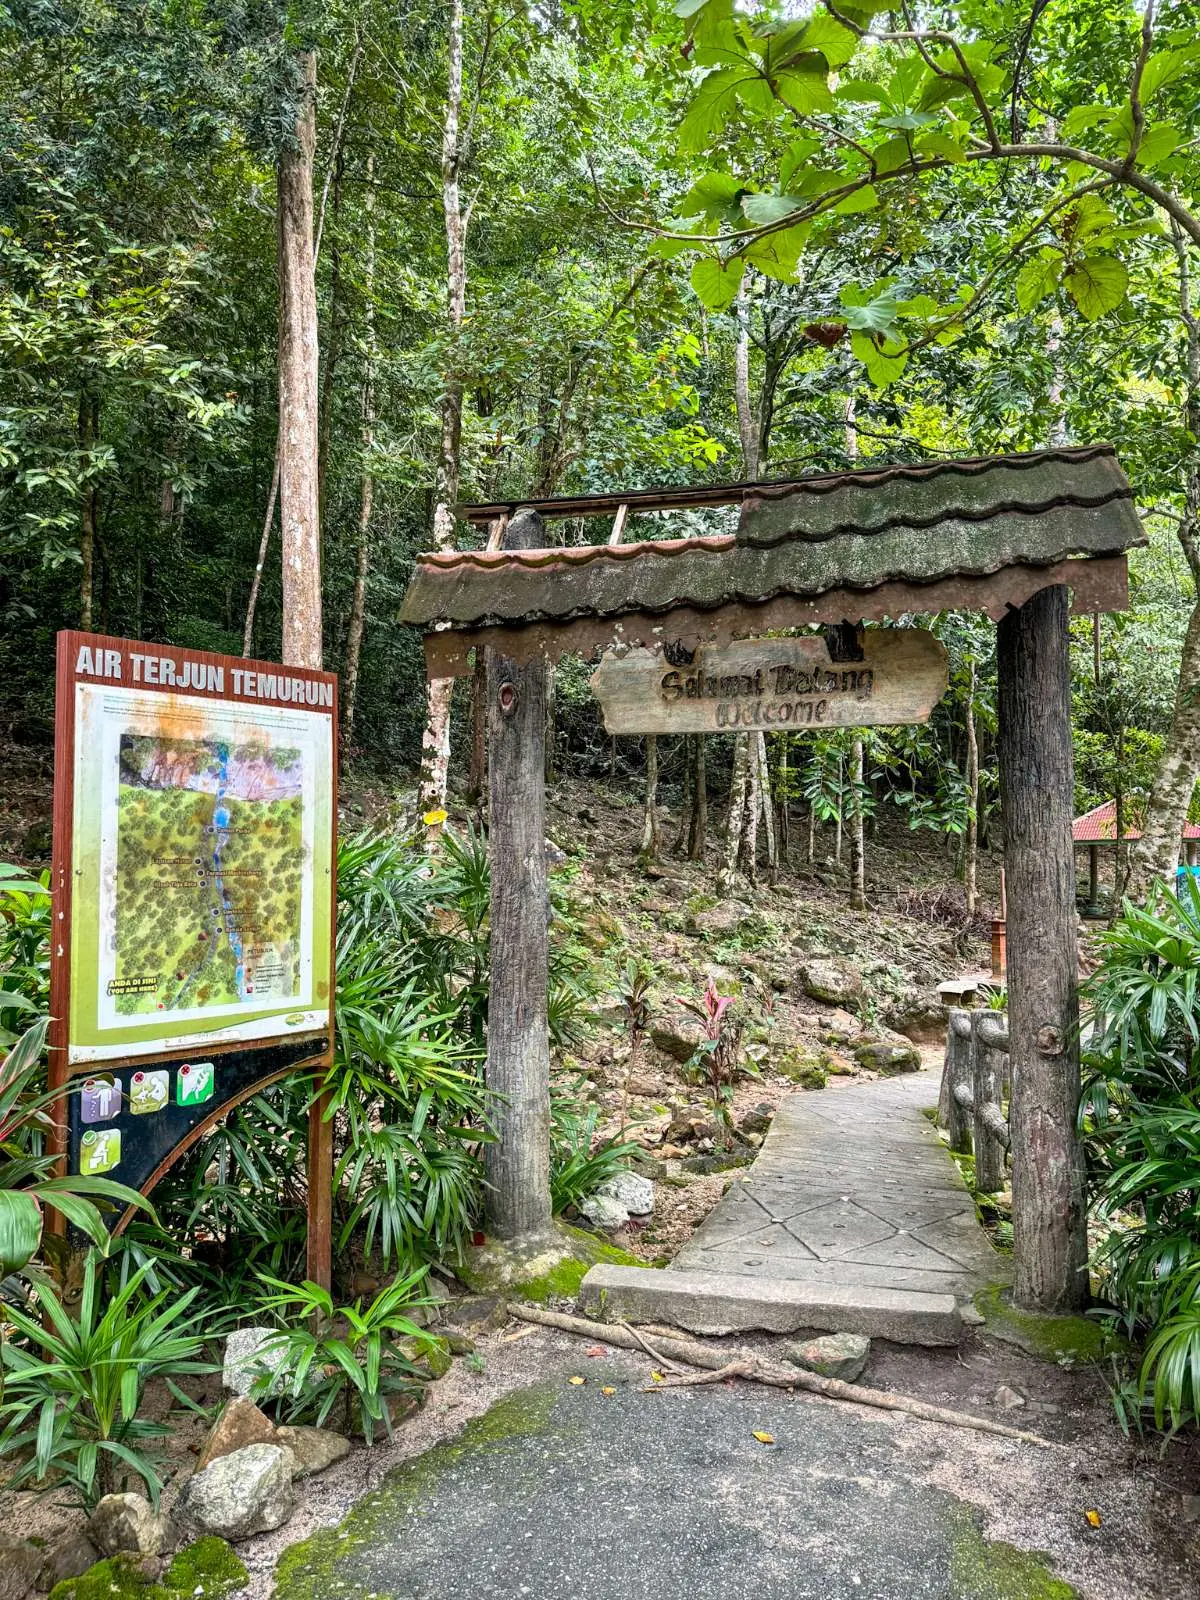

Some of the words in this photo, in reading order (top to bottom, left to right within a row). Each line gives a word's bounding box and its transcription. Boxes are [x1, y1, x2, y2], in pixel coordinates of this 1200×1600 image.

[75, 645, 122, 679] AIR
[129, 652, 225, 693] TERJUN
[230, 667, 333, 707] TEMURUN
[107, 988, 125, 996] (YOU
